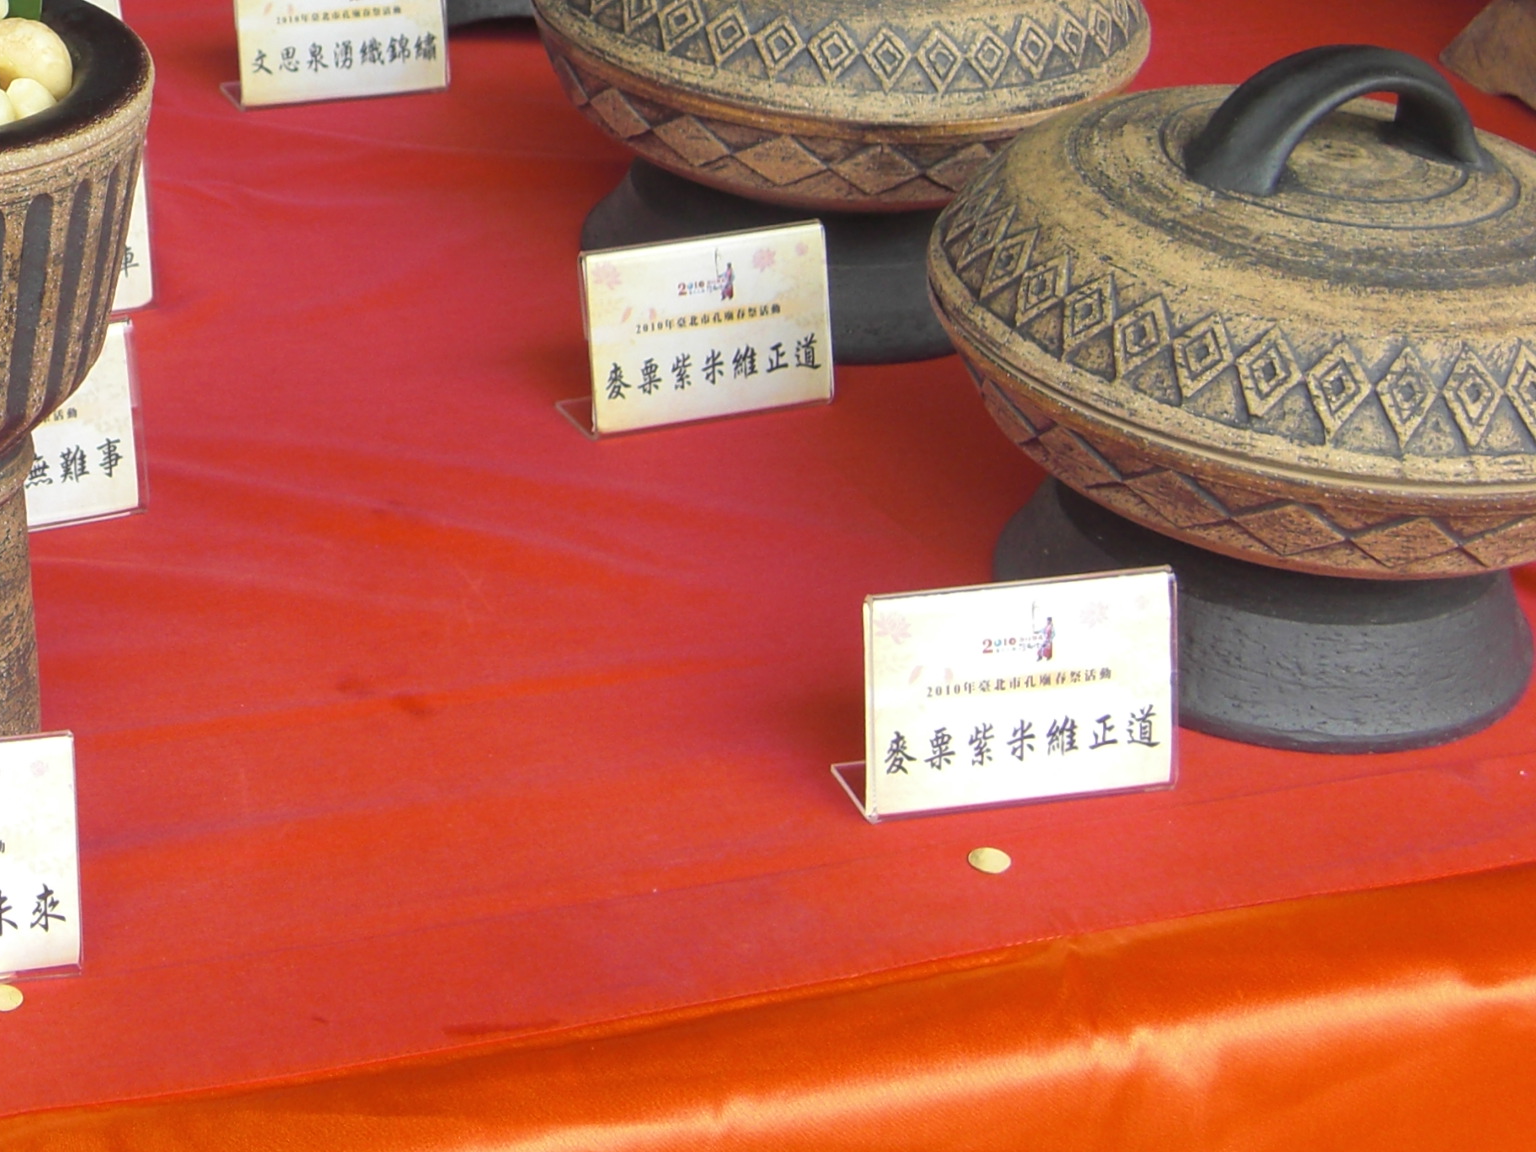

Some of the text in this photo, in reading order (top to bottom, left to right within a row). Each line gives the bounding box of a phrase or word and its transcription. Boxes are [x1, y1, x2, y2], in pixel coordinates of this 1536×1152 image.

[252, 31, 437, 75] 文思泉湧織錦繡
[636, 304, 782, 334] 2010年臺北市孔廟春祭活動
[926, 667, 1112, 698] 2010年臺北市孔廟春祭活動
